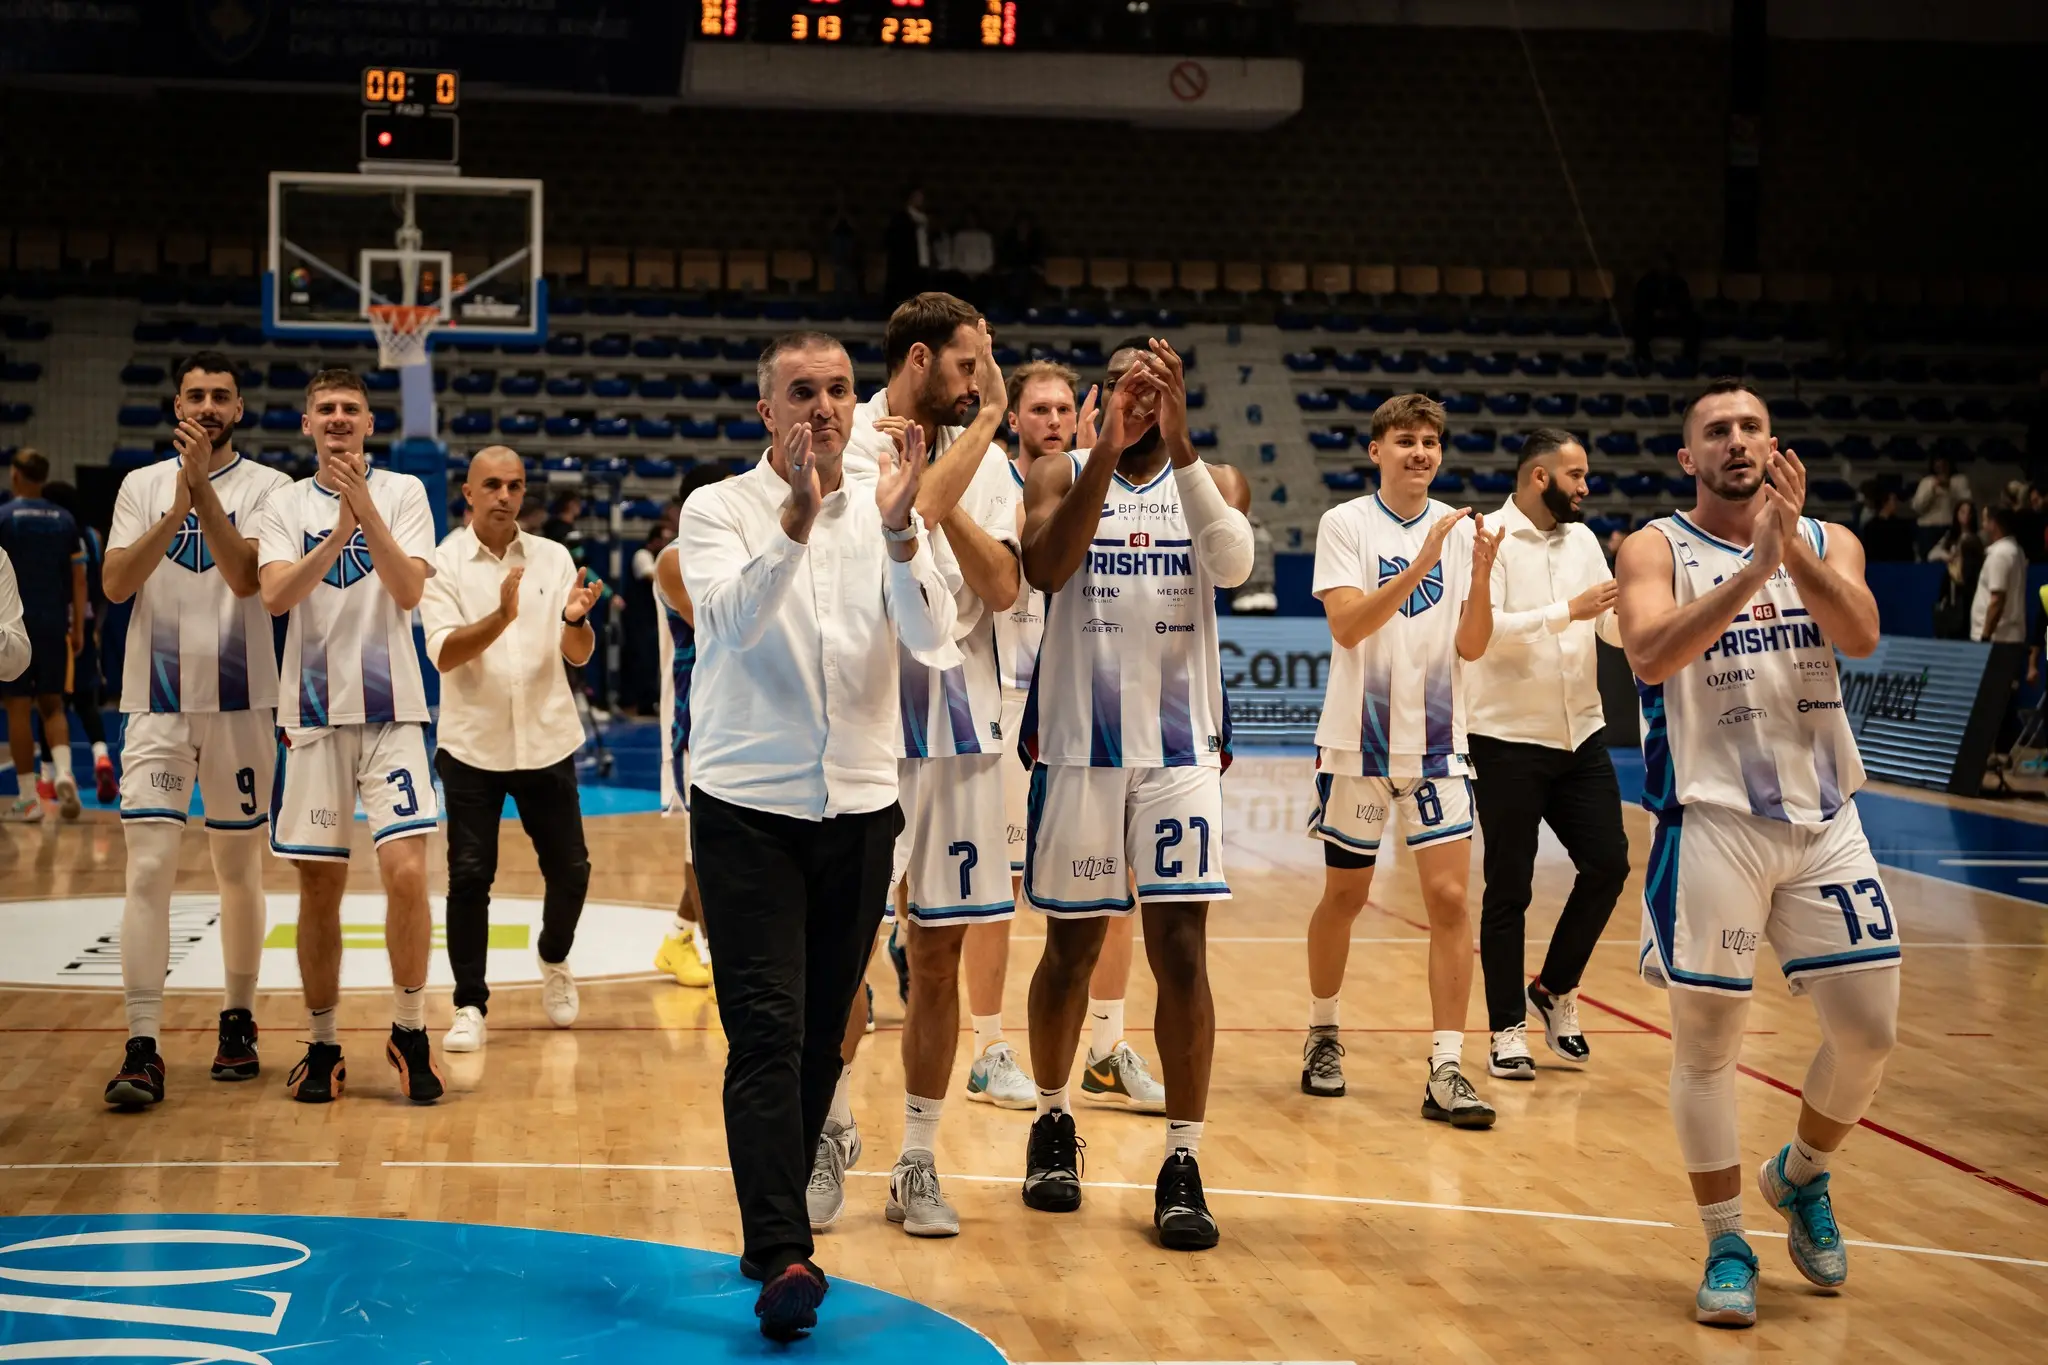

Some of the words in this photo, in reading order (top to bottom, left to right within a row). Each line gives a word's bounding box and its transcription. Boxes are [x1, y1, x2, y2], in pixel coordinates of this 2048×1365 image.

[1118, 503, 1137, 514] BP
[1140, 503, 1179, 514] HOME
[1704, 623, 1825, 661] PRISHTIN
[1717, 711, 1768, 726] ALBERTI
[150, 771, 186, 792] vipa
[235, 767, 257, 816] 9
[386, 768, 419, 817] 3
[1414, 780, 1444, 827] 8
[948, 841, 979, 900] 7
[1072, 855, 1119, 881] vipa
[1154, 816, 1210, 878] 21
[1819, 877, 1894, 945] 13
